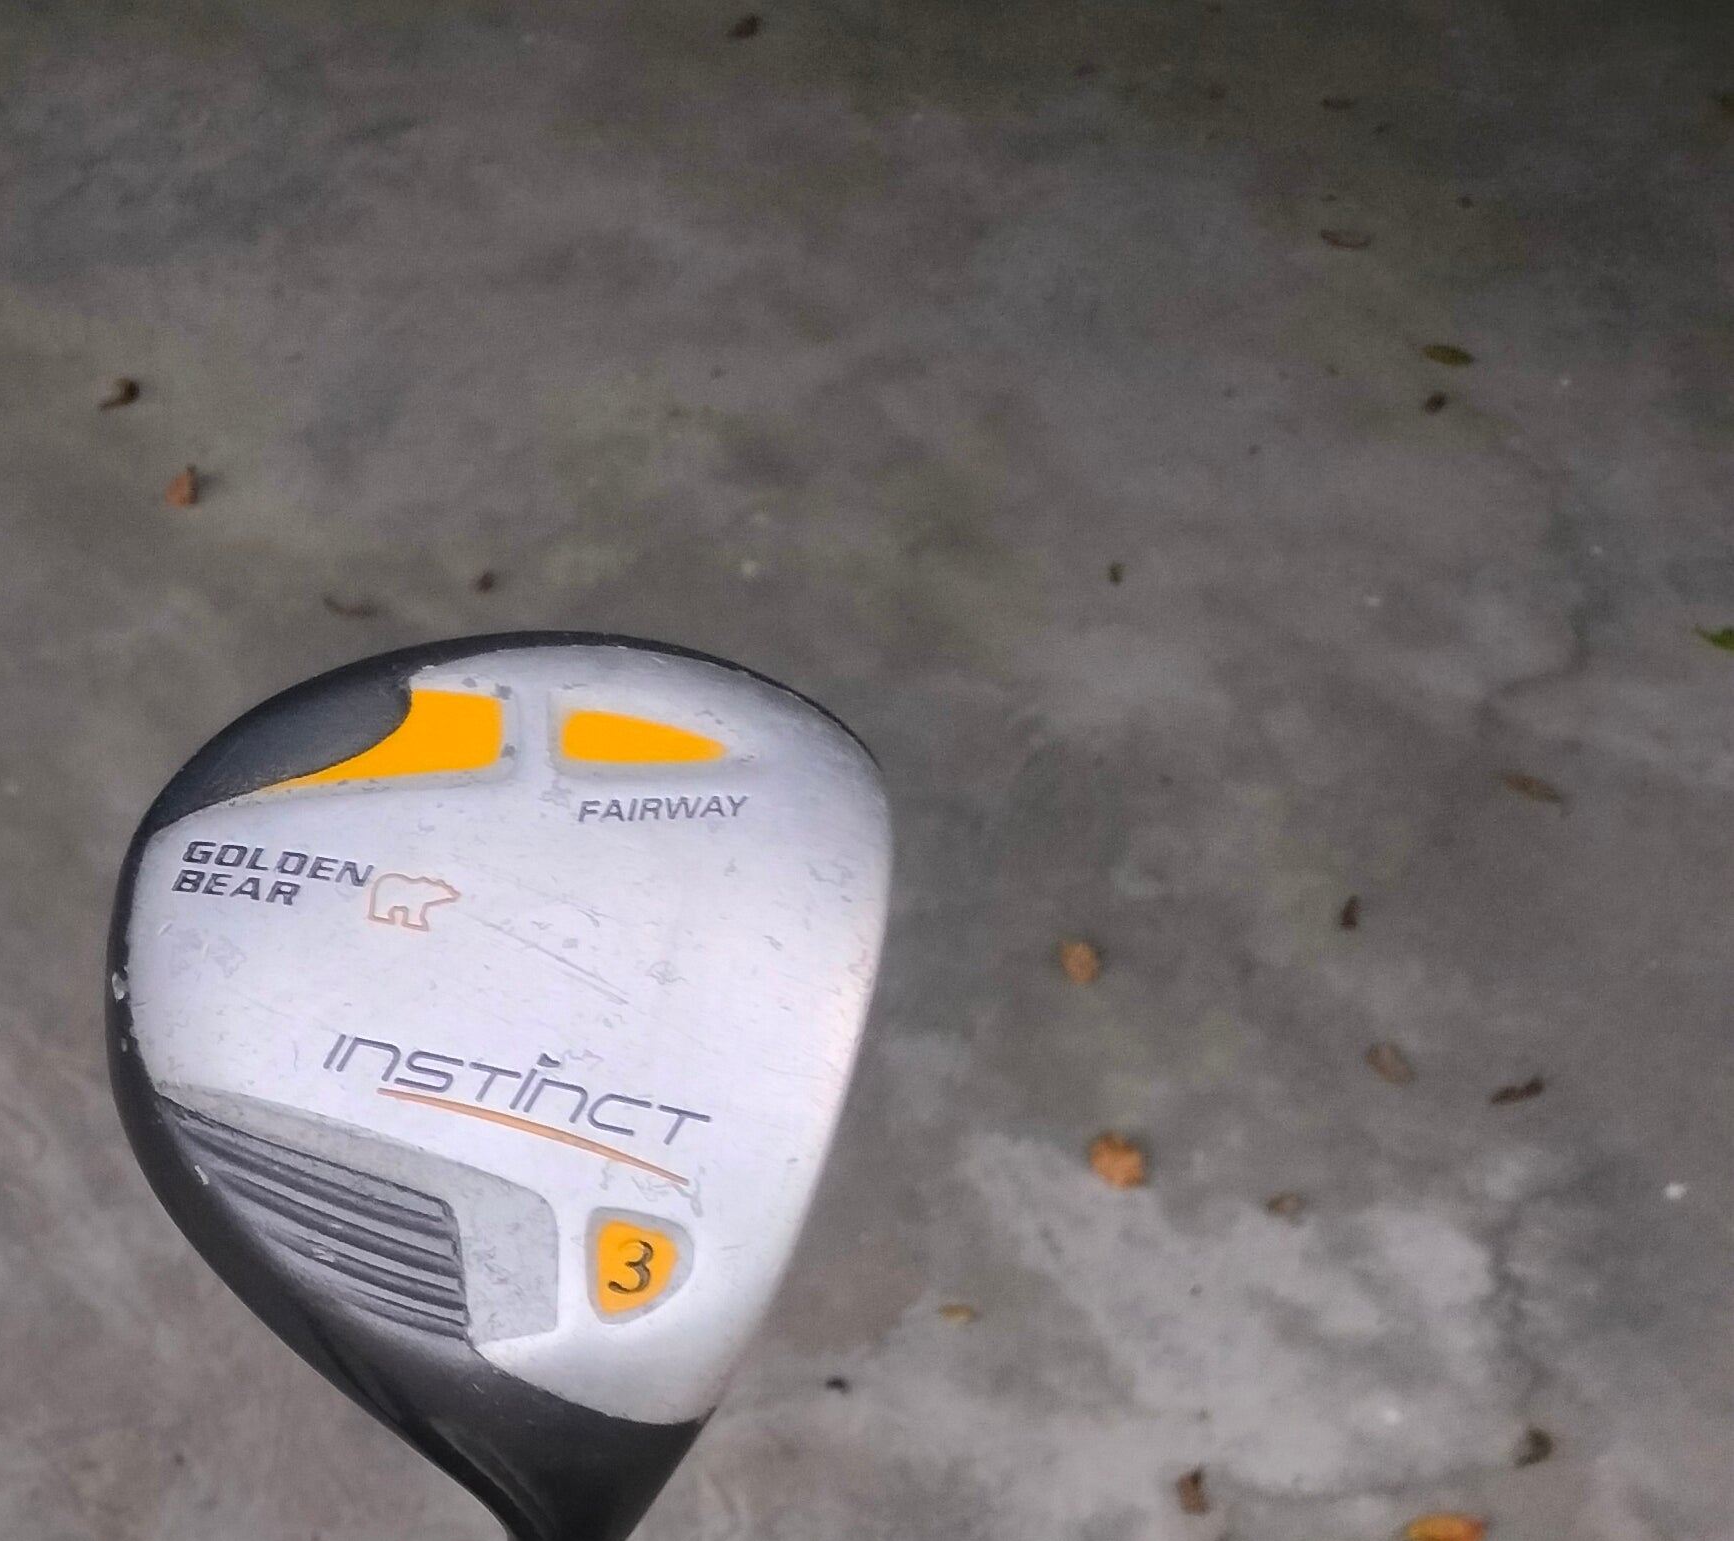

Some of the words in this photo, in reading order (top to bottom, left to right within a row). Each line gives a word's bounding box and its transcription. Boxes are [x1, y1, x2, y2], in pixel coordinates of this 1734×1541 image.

[577, 795, 748, 823] FAIRWAY
[182, 841, 373, 888] GOLDEN
[171, 869, 301, 906] BEAR
[607, 1239, 655, 1295] 3
